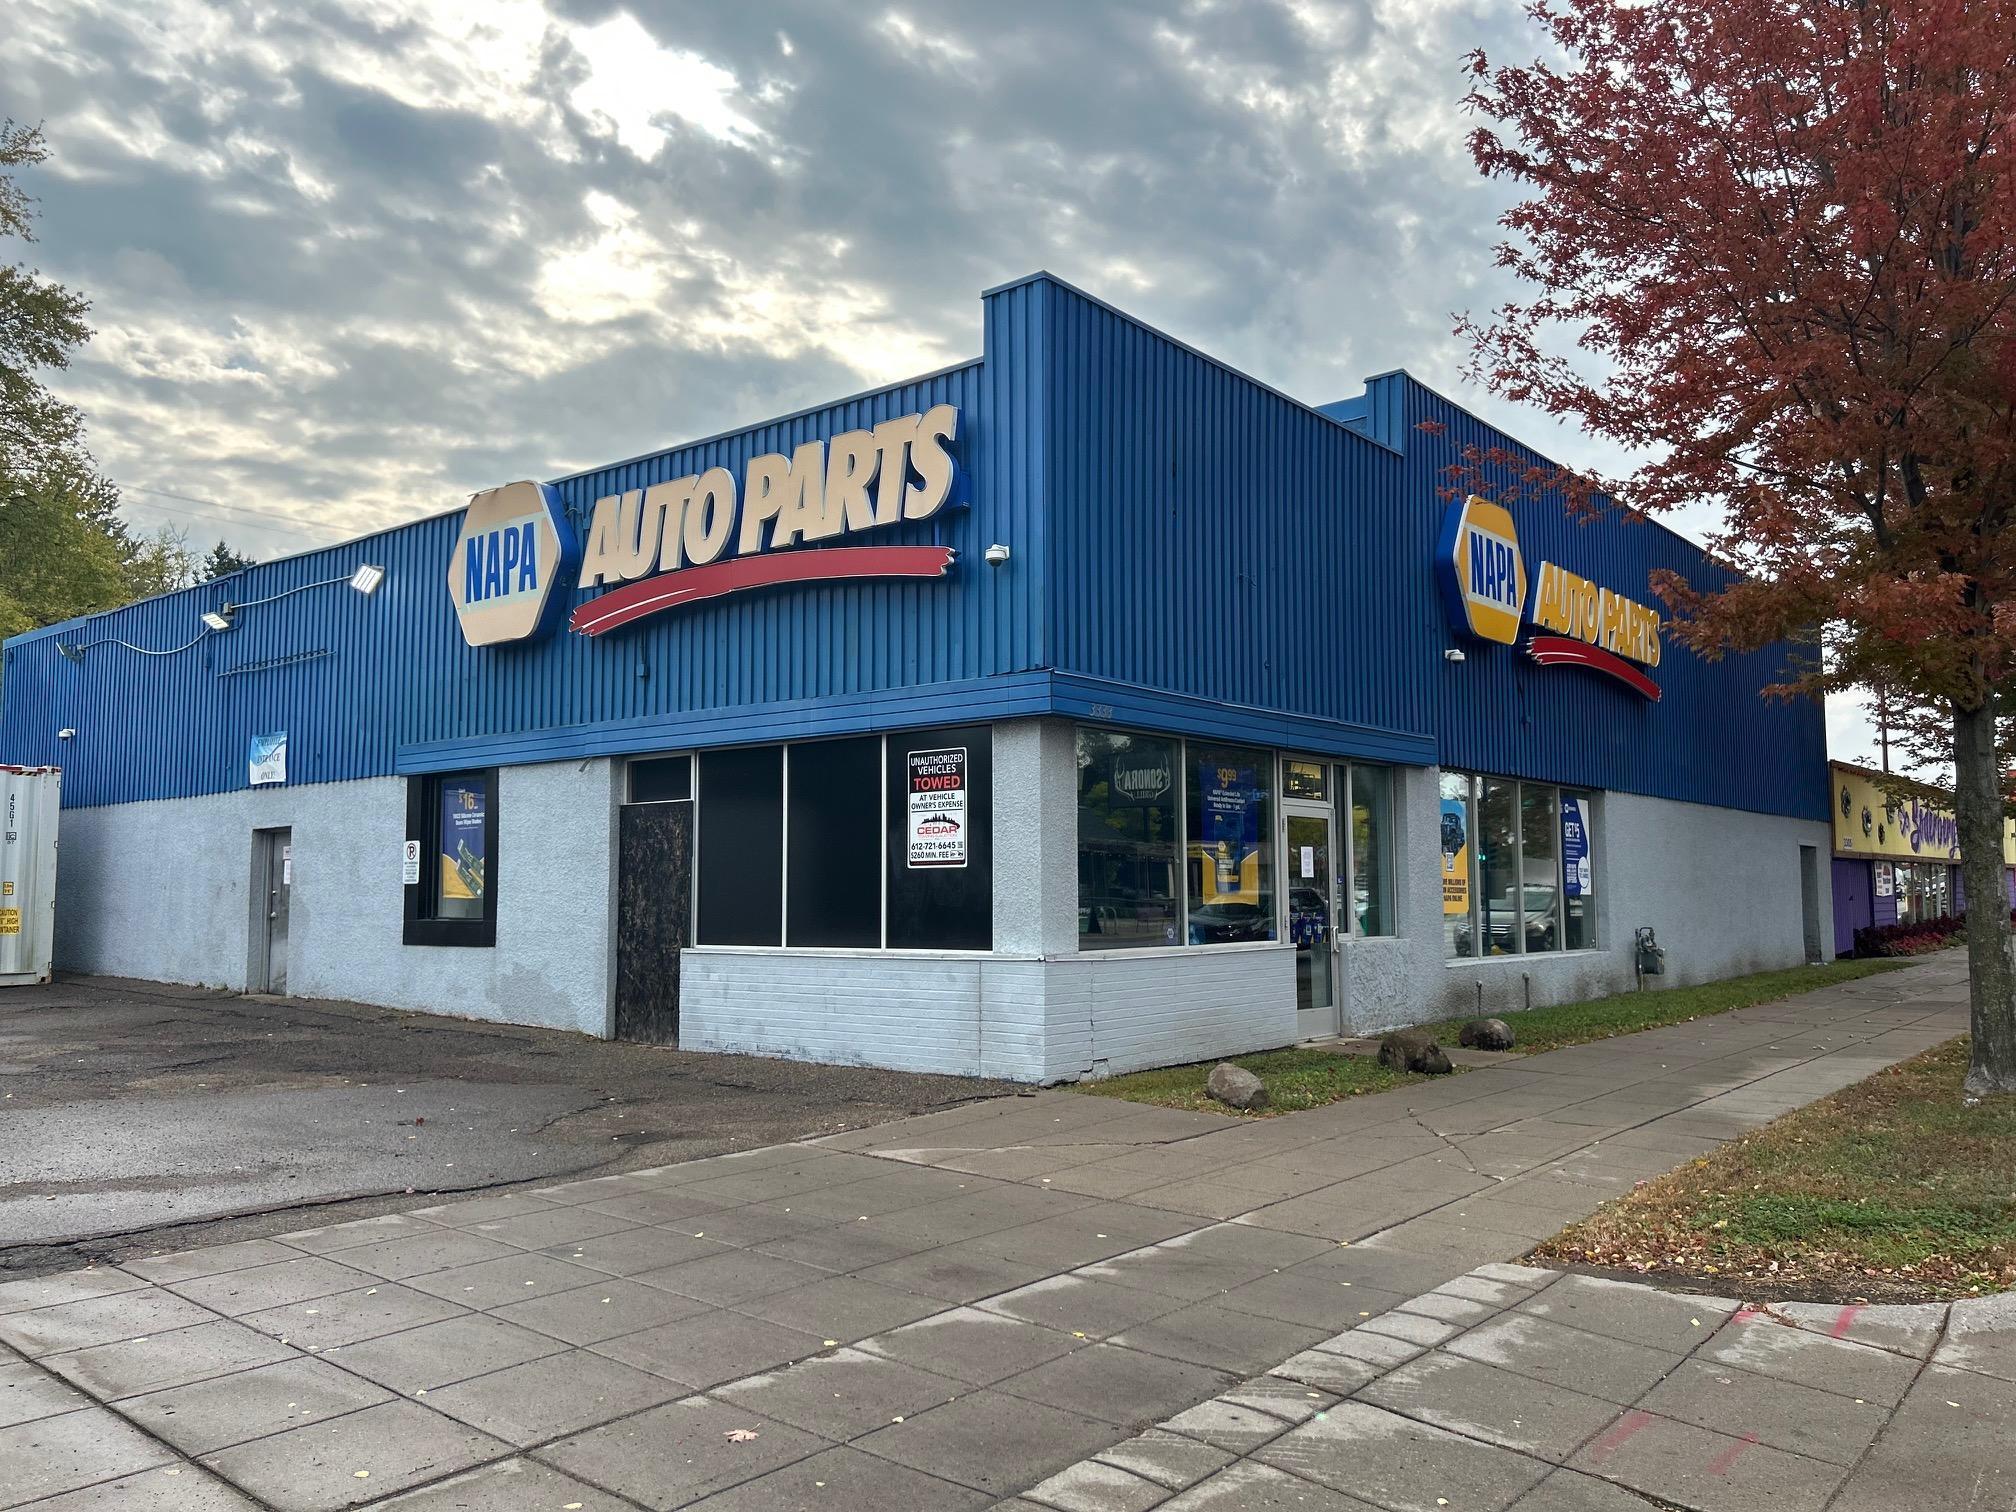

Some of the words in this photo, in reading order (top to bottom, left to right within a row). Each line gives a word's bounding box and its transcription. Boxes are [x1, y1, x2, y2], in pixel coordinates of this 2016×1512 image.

[578, 466, 738, 589] AUTO
[738, 404, 959, 554] PARTS
[465, 521, 537, 604] NAPA
[1470, 531, 1517, 608] NAPA
[1532, 560, 1600, 645] AUTO
[1599, 586, 1661, 668] PARTS
[911, 754, 963, 766] UNAUTHORIZED
[918, 764, 956, 775] VEHICLES
[914, 776, 960, 790] TOWED
[917, 826, 957, 834] CEDAR
[911, 842, 956, 850] 612-721-6645
[911, 851, 924, 859] $260
